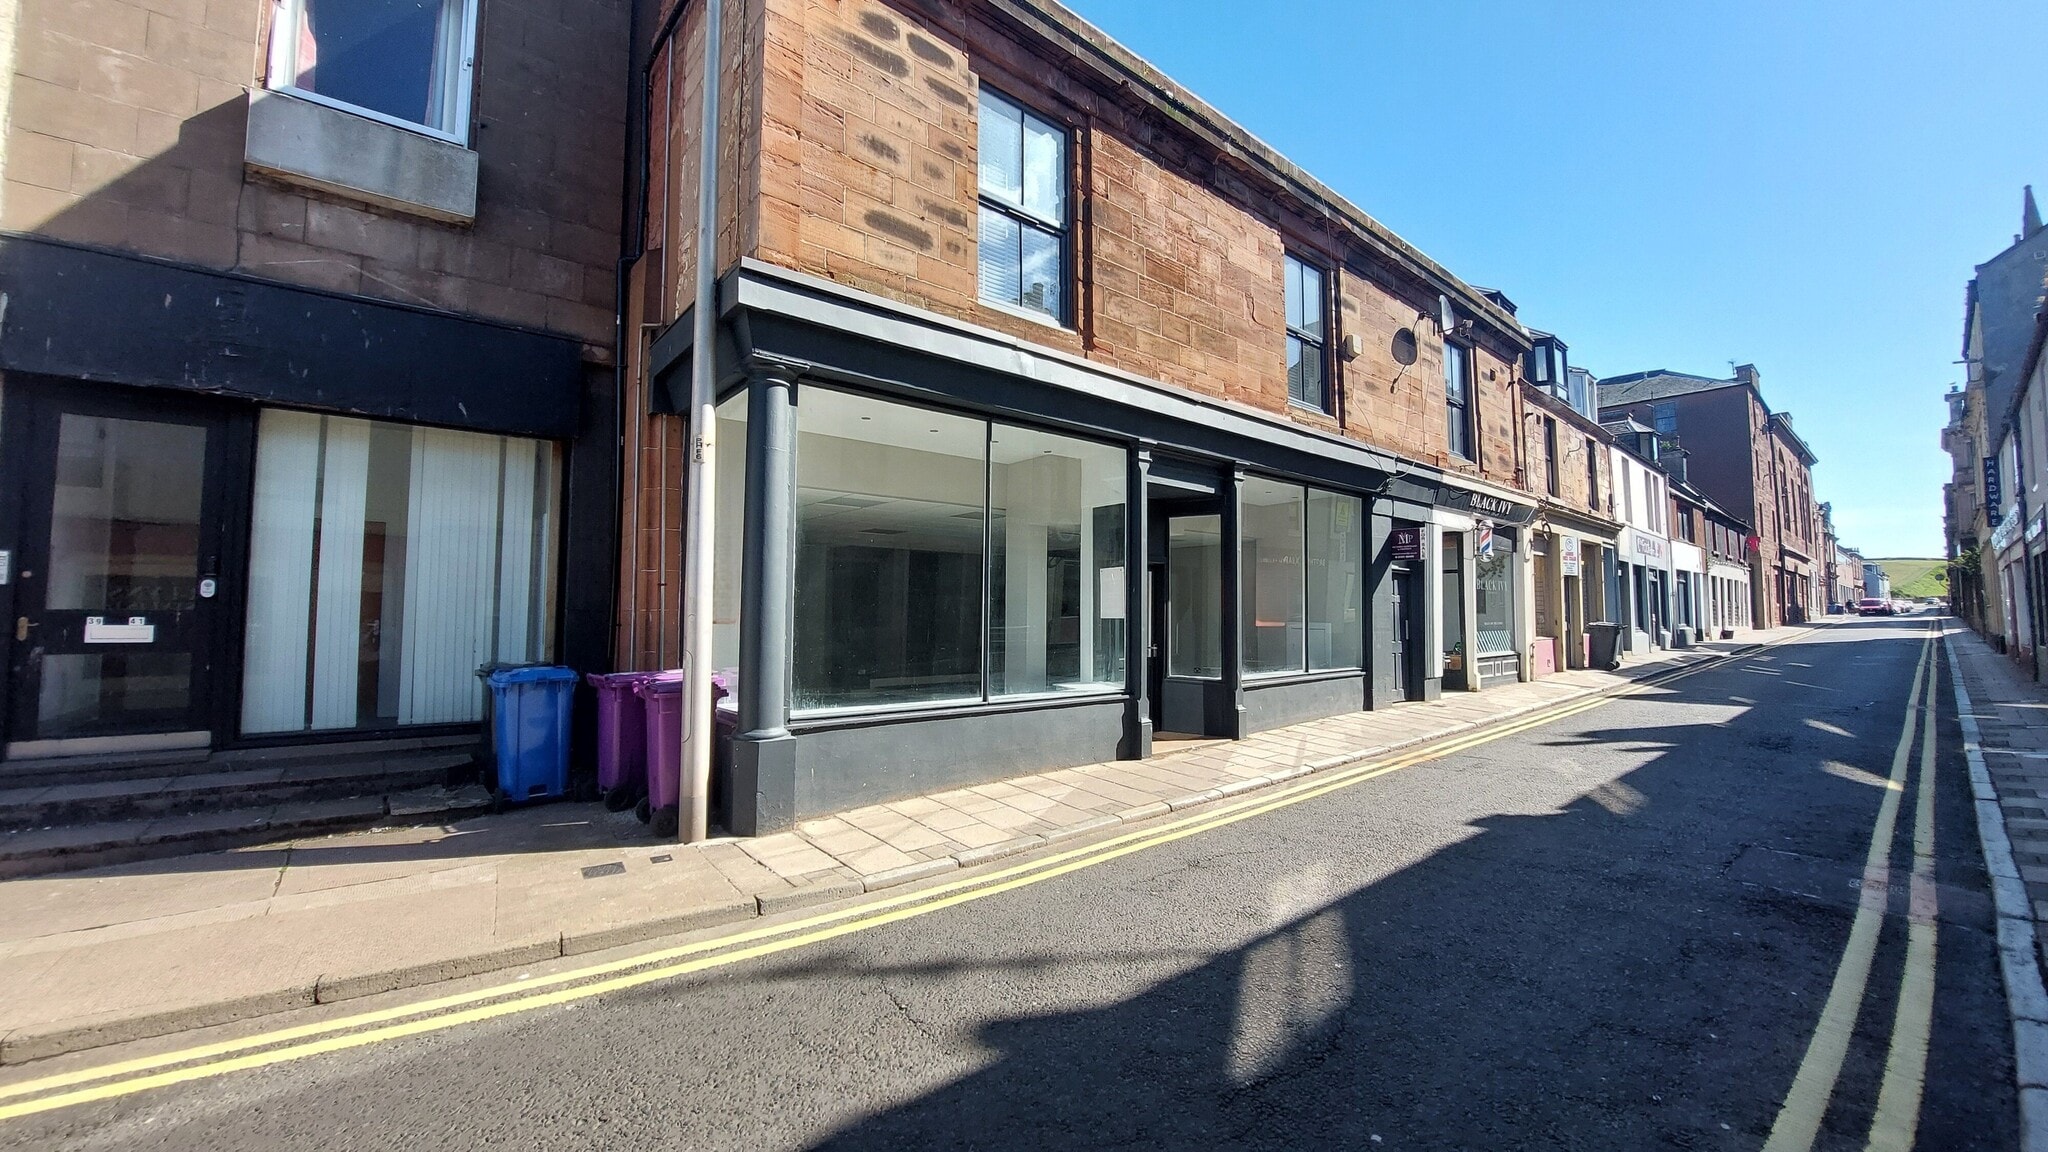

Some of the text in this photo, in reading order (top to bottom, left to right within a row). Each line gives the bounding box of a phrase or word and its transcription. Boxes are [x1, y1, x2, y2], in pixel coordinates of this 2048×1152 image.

[1470, 493, 1498, 511] BLACK
[1497, 500, 1514, 515] IVY
[1987, 460, 1999, 526] HARDWARE
[1476, 578, 1497, 591] BLACK
